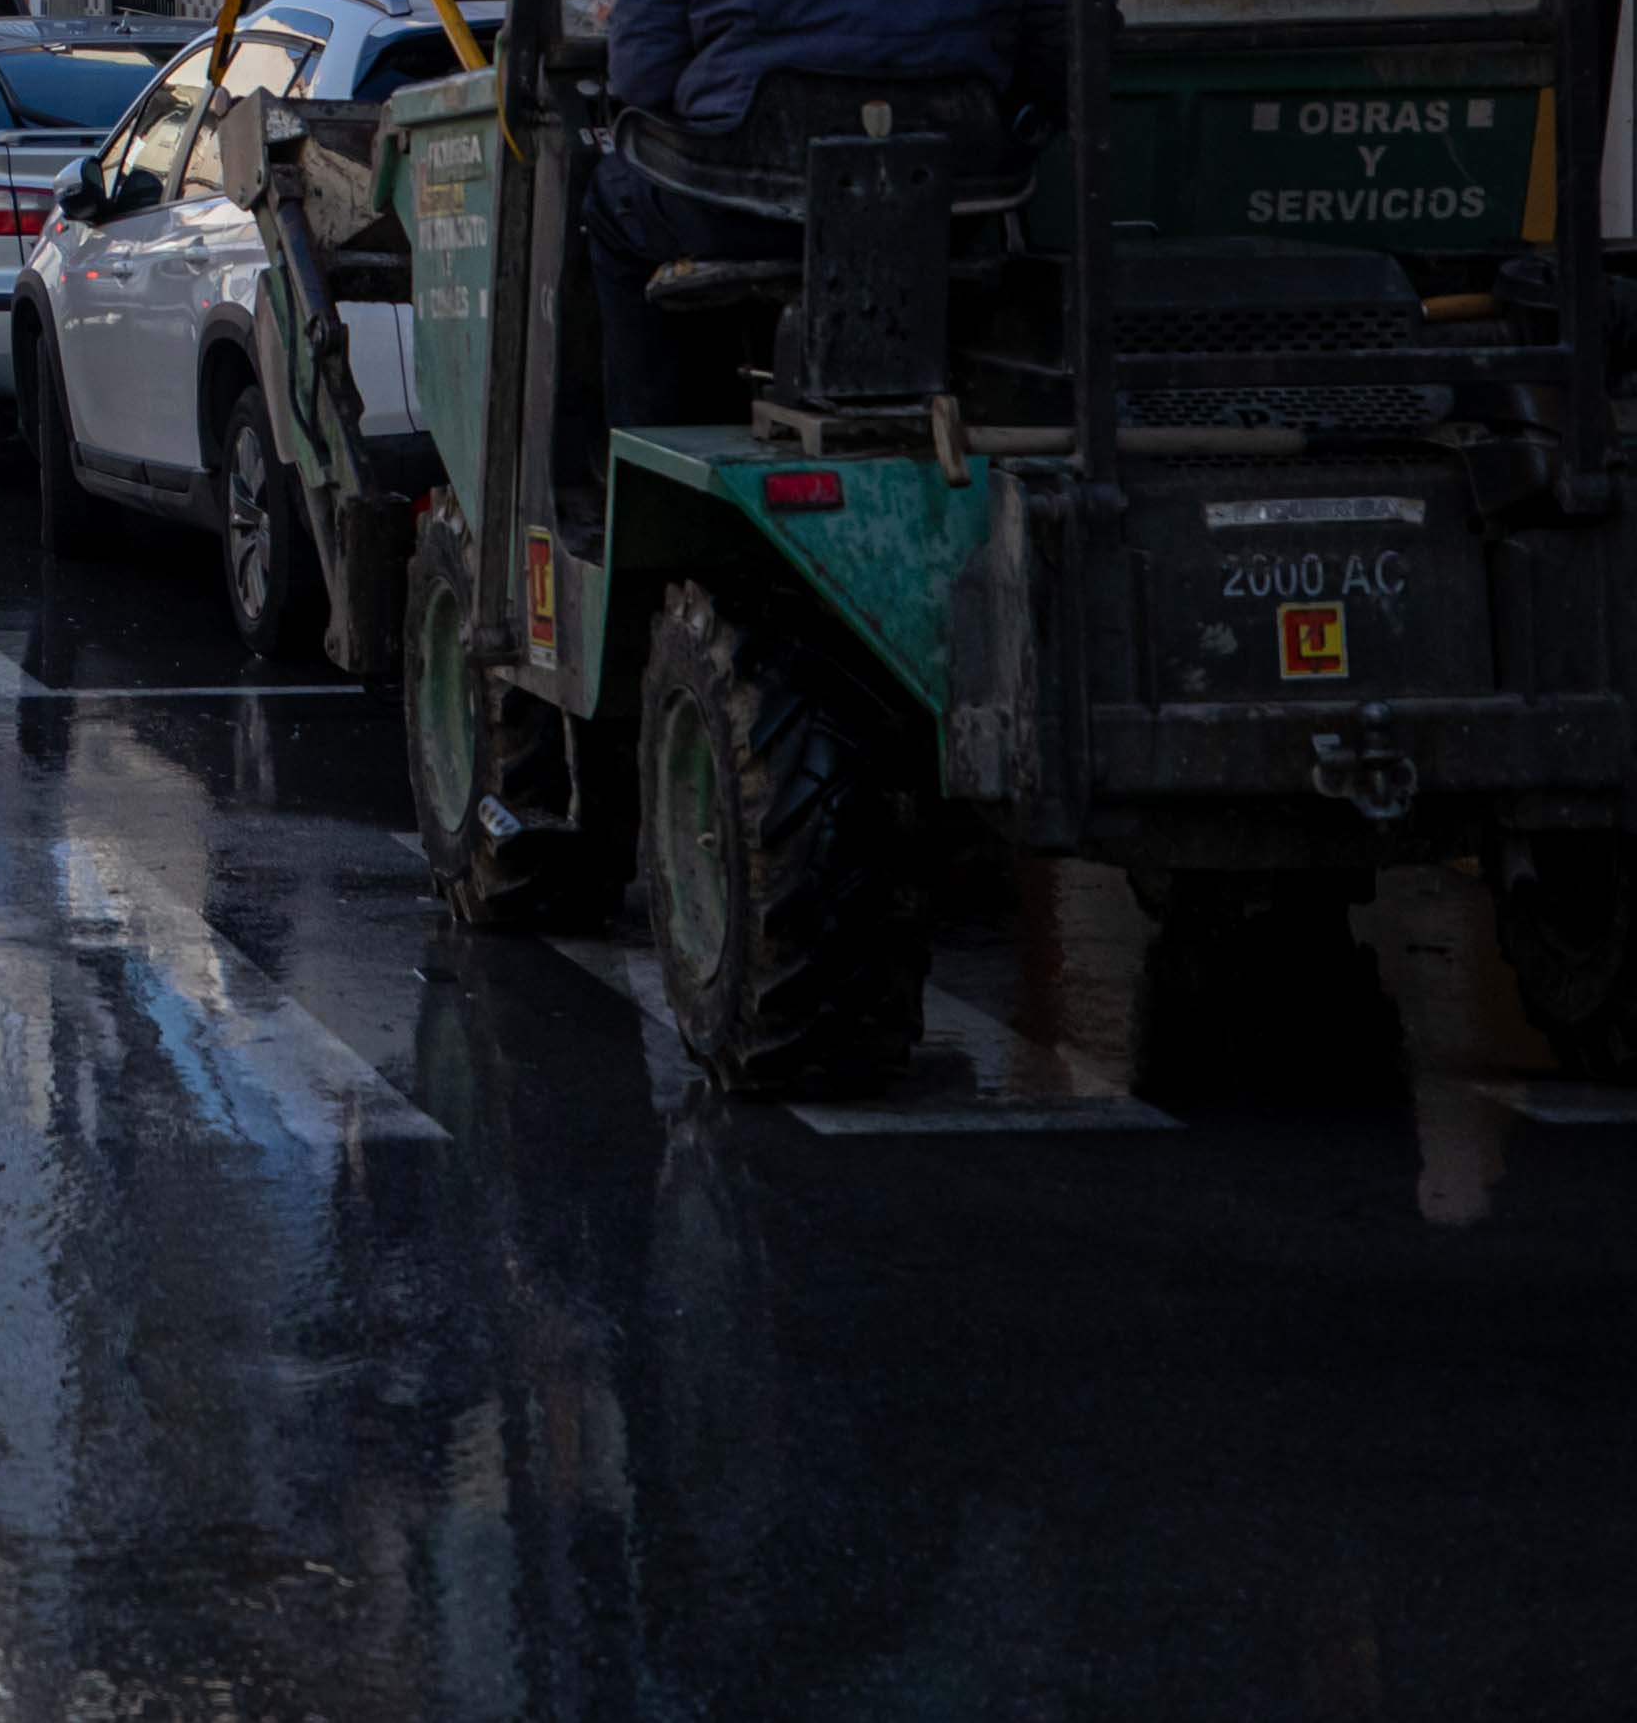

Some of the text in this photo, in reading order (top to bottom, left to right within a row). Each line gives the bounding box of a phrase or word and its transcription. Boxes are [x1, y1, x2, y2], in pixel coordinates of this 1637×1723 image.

[1299, 100, 1449, 135] OBRAS
[1357, 144, 1390, 179] Y
[1246, 185, 1487, 224] SERVICIOS
[1222, 549, 1406, 598] 2000 AC
